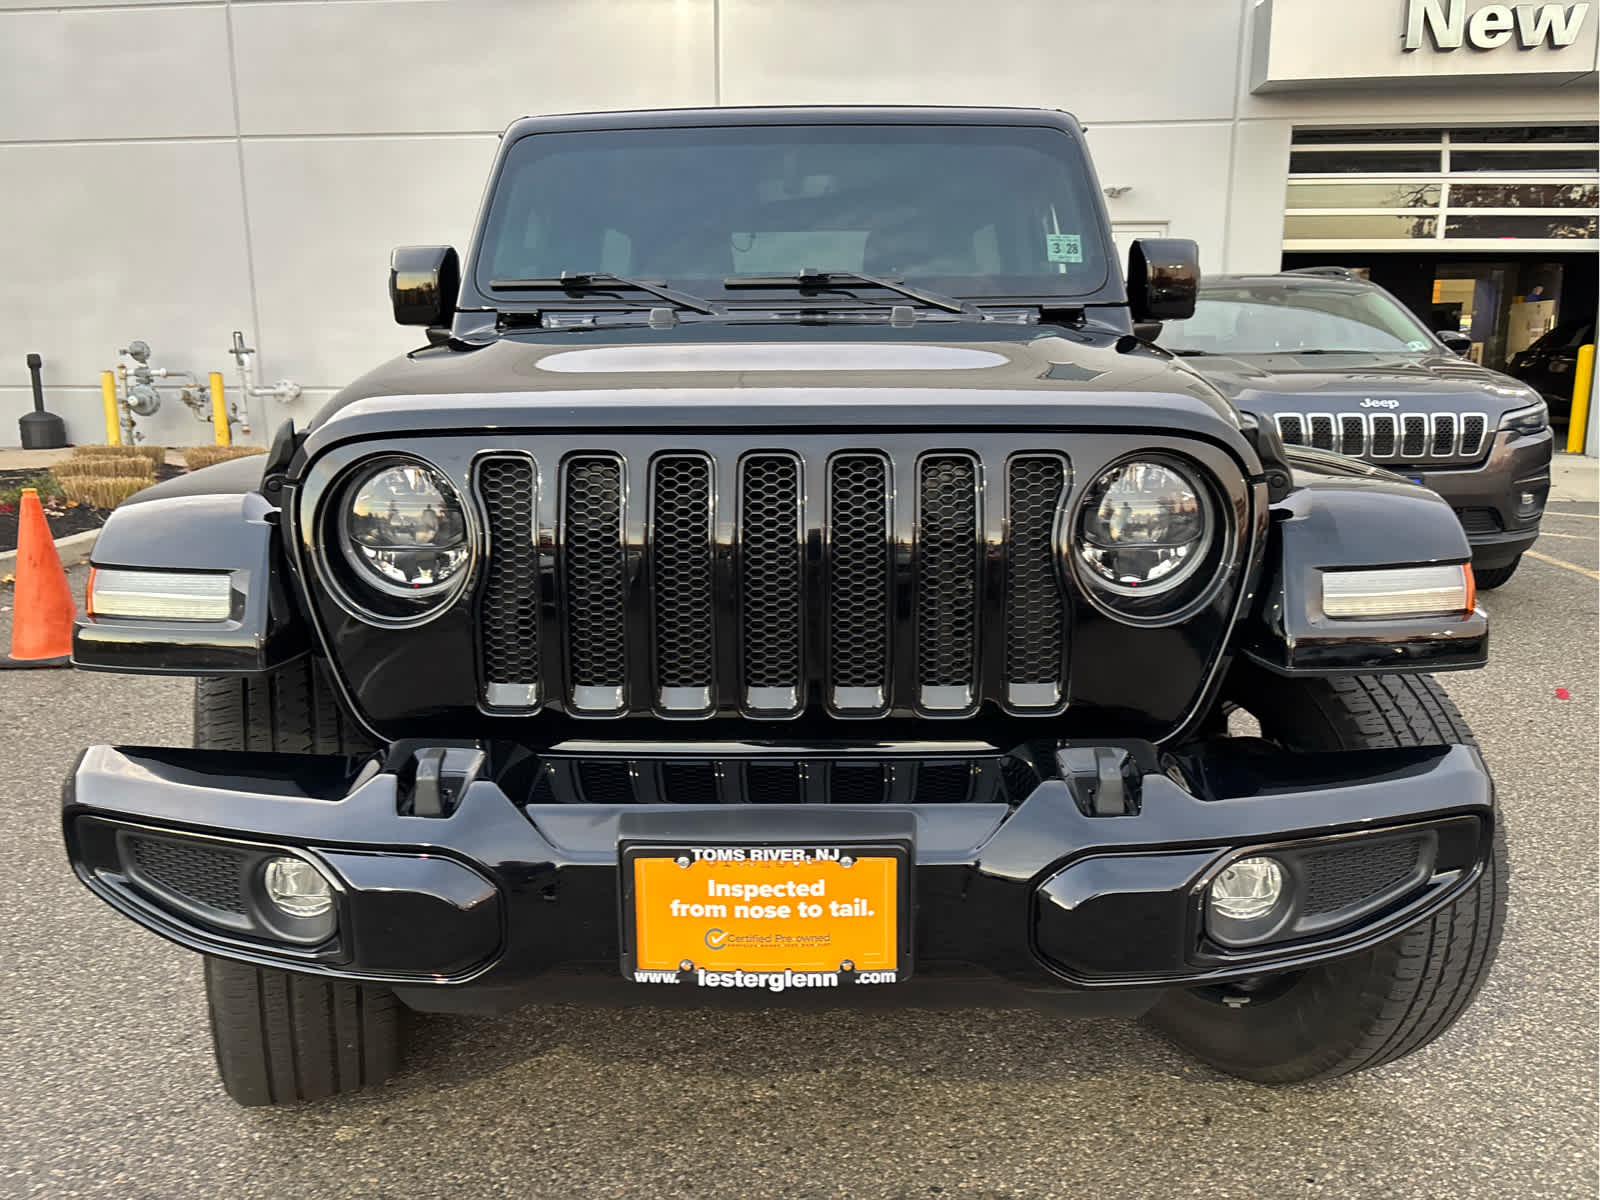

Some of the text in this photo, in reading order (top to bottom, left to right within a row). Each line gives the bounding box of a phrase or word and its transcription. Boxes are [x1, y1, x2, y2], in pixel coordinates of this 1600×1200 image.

[1404, 0, 1590, 50] New
[1052, 243, 1061, 254] 3
[1360, 398, 1400, 409] Jeep
[692, 849, 745, 862] TOMS
[816, 849, 840, 861] NJ
[707, 879, 825, 901] Inspected
[670, 898, 875, 919] from nose to tail.
[728, 934, 772, 943] Certified
[634, 969, 897, 992] www. lesterglenn .com
